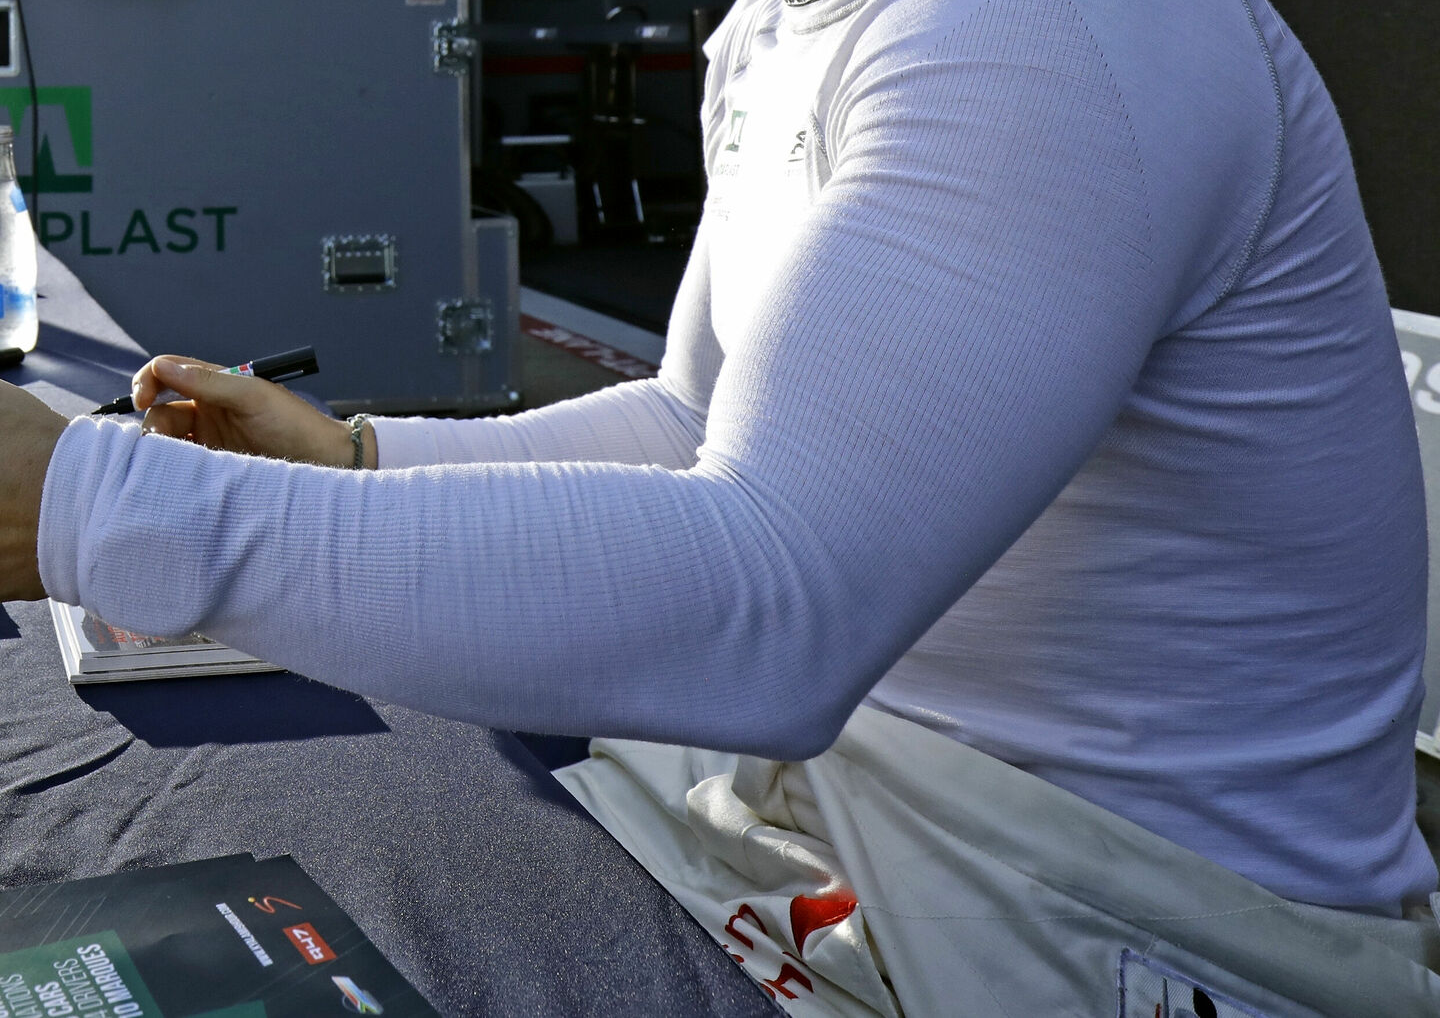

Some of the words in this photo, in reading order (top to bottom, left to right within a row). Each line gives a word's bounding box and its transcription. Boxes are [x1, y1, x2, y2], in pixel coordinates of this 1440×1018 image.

[34, 981, 74, 1017] CARS
[53, 958, 105, 1012] DRIVERS
[76, 943, 134, 1005] MARQUES
